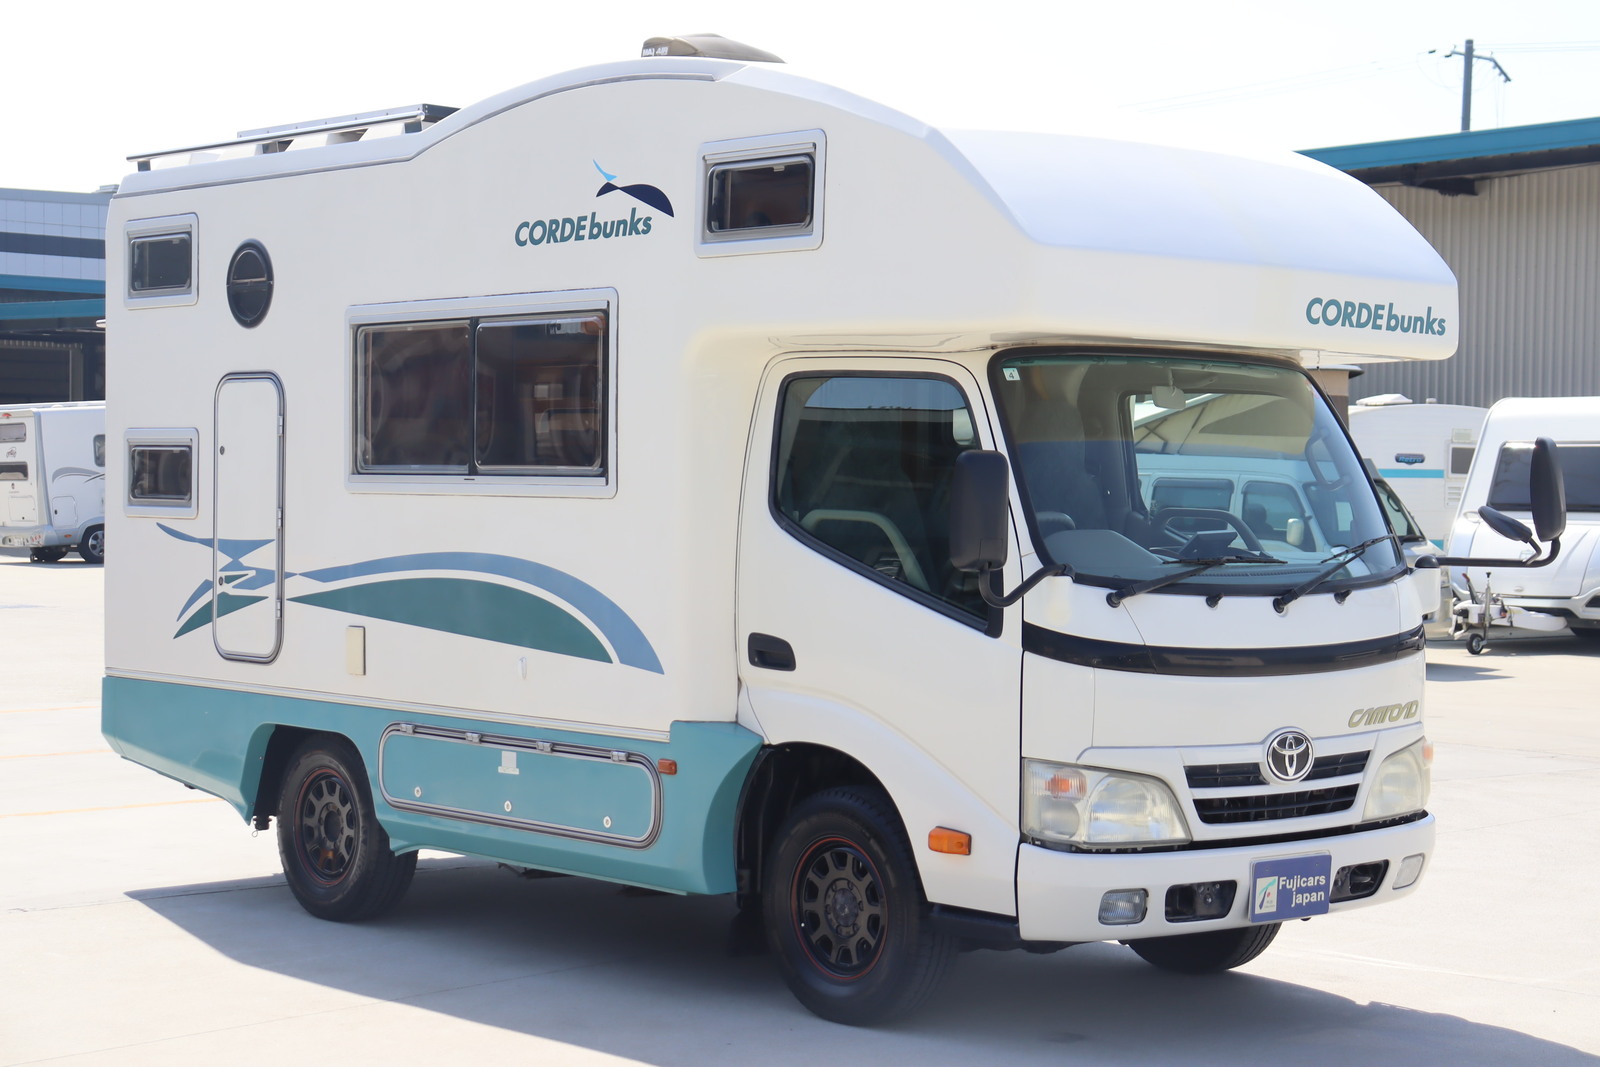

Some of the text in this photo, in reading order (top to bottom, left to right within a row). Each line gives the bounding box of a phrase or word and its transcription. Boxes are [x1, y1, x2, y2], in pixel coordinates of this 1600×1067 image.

[1348, 700, 1419, 728] CAMROAD
[1279, 875, 1326, 891] Fujicars
[1291, 891, 1325, 907] japan
